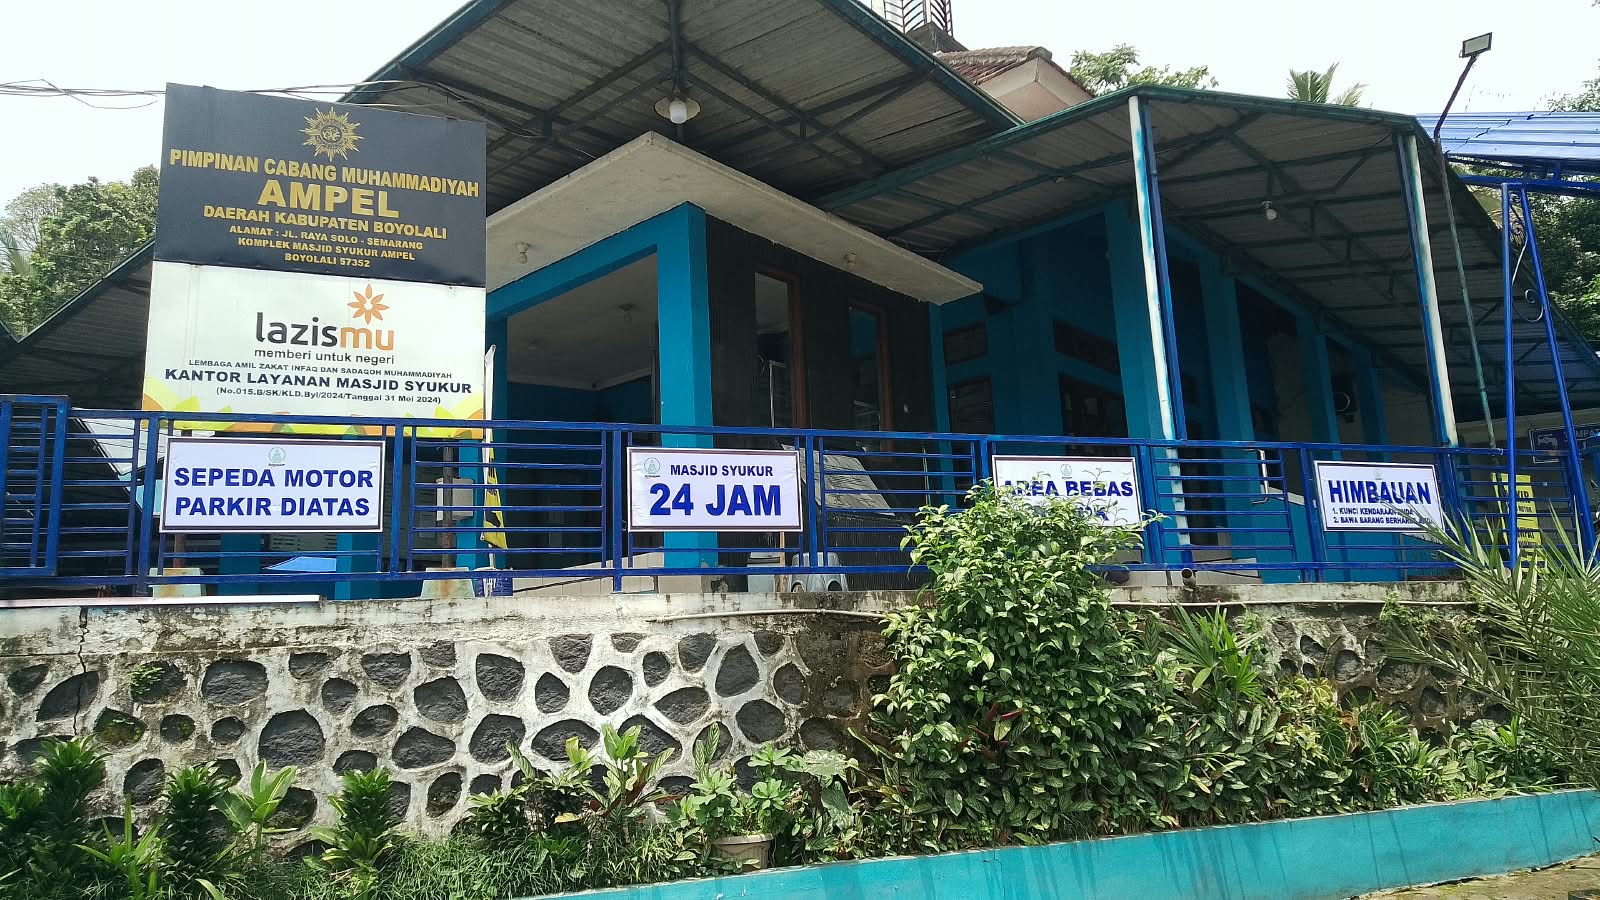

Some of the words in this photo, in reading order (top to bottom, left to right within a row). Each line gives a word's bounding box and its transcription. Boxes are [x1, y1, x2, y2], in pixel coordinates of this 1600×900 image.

[169, 148, 258, 173] PIMPINAN
[264, 158, 336, 182] CABANG
[342, 166, 480, 197] MUHAMMADIYAH
[257, 179, 399, 218] AMPEL
[203, 205, 270, 223] DAERAH
[275, 212, 369, 232] KABUPATEN
[373, 220, 447, 240] BOYOLALI
[229, 225, 273, 236] ALAMAT
[281, 229, 298, 239] JL.
[300, 231, 328, 241] RAYA
[330, 234, 358, 244] SOLO
[367, 237, 423, 250] SEMARANG
[238, 237, 290, 249] KOMPLEK
[292, 242, 332, 253] MASJID
[335, 245, 378, 257] SYUKUR
[380, 250, 415, 261] AMPEL
[284, 253, 337, 265] BOYOLALI
[339, 257, 370, 267] 57352
[255, 312, 394, 351] lazismu
[254, 348, 311, 361] memberi
[316, 351, 351, 363] untuk
[356, 354, 394, 365] negeri
[189, 359, 233, 368] LEMBAGA
[259, 363, 288, 371] ZAKAT
[320, 366, 338, 374] DAN
[384, 370, 452, 379] MUHAMMADIYAH
[165, 368, 241, 384] KANTOR
[247, 371, 330, 388] LAYANAN
[336, 377, 399, 391] MASJID
[404, 380, 472, 394] SYUKUR
[417, 396, 441, 404] 2024)
[174, 467, 275, 487] SEPEDA
[284, 469, 373, 488] MOTOR
[670, 464, 717, 476] MASJID
[721, 465, 773, 477] SYUKUR
[1065, 480, 1133, 497] BEBAS
[1328, 480, 1431, 504] HIMBAUAN
[175, 497, 272, 516] PARKIR
[280, 497, 370, 516] DIATAS
[649, 483, 693, 516] 24
[706, 484, 781, 516] JAM
[1339, 507, 1359, 515] KUNCI
[1340, 516, 1359, 524] BAWA
